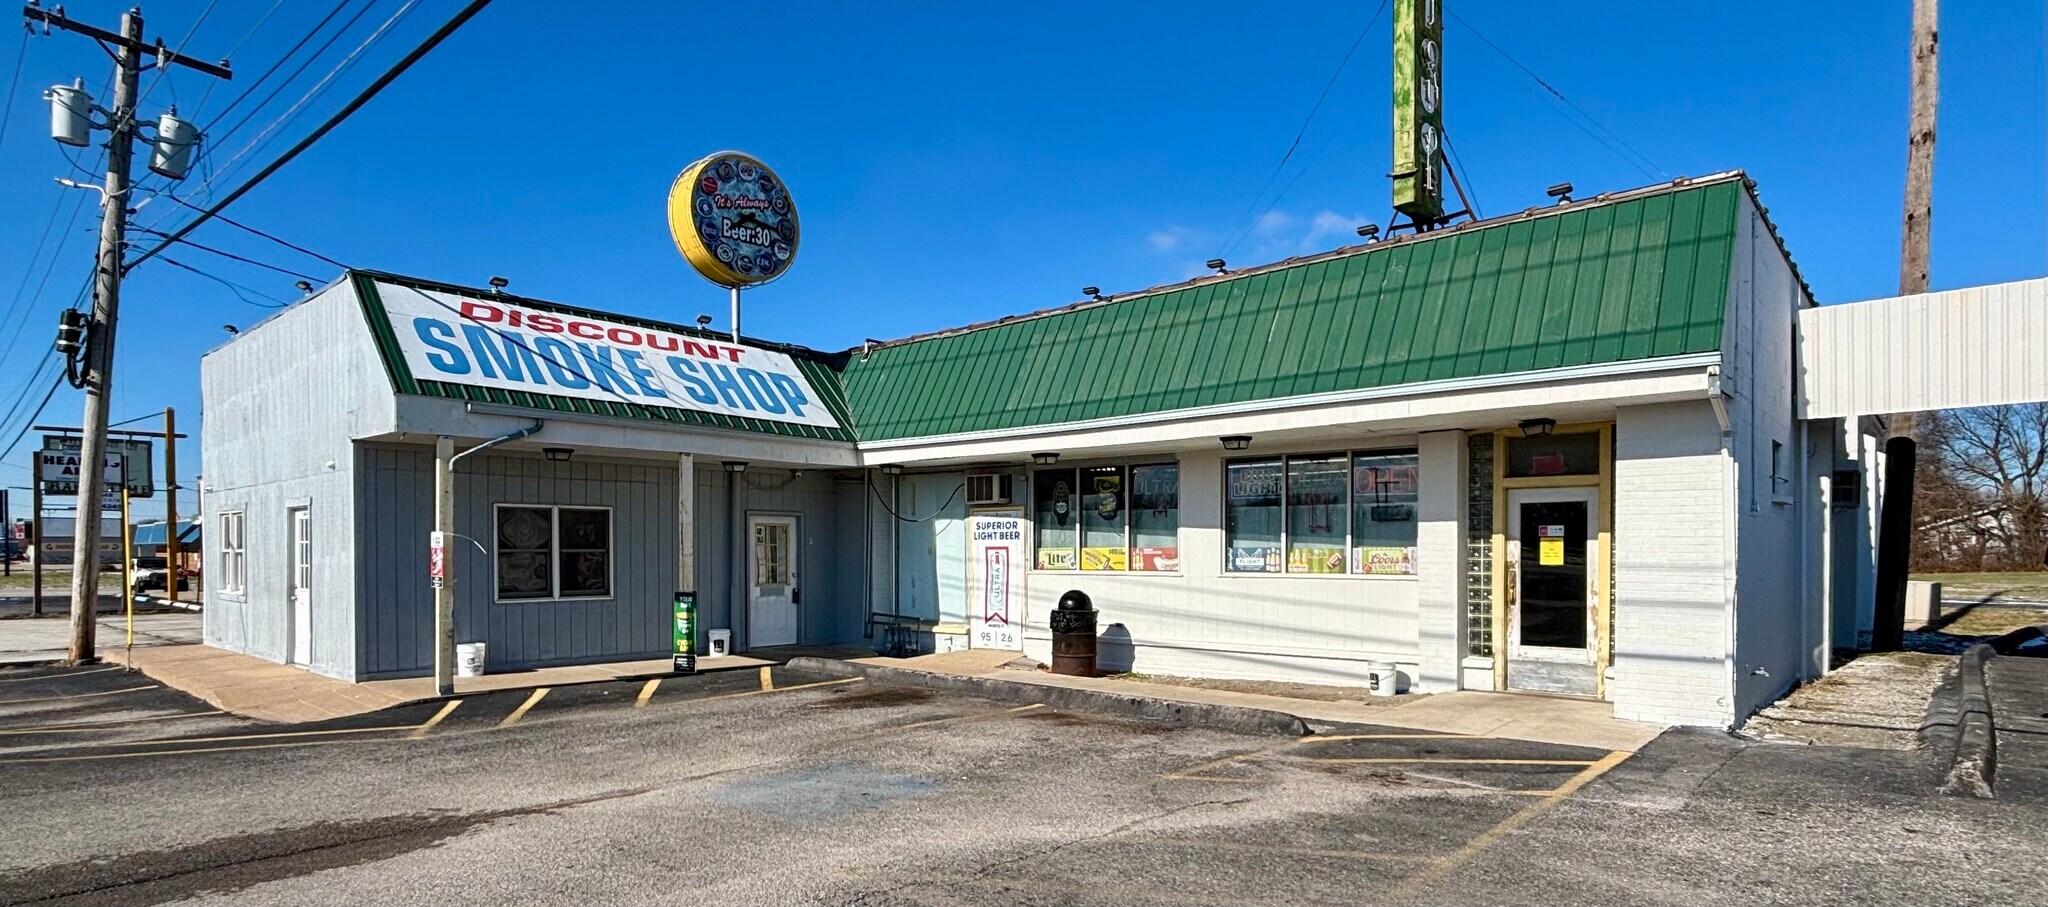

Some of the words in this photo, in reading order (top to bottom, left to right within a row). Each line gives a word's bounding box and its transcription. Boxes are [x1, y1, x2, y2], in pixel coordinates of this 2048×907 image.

[714, 194, 733, 209] It's
[734, 195, 771, 213] Always
[721, 218, 771, 247] Beer:30
[458, 300, 745, 364] DISCOUNT
[412, 316, 669, 398] SMOKE
[667, 355, 809, 417] SHOP
[1240, 468, 1276, 482] BUD
[1356, 467, 1418, 493] OPEN
[1233, 481, 1283, 496] LIGHT
[976, 520, 1018, 531] SUPERIOR
[973, 531, 997, 541] LIGHT
[999, 531, 1021, 541] BEER
[1047, 553, 1067, 566] Lite
[1371, 553, 1400, 564] Coors
[993, 567, 1001, 598] ULTRA
[980, 631, 991, 641] 95
